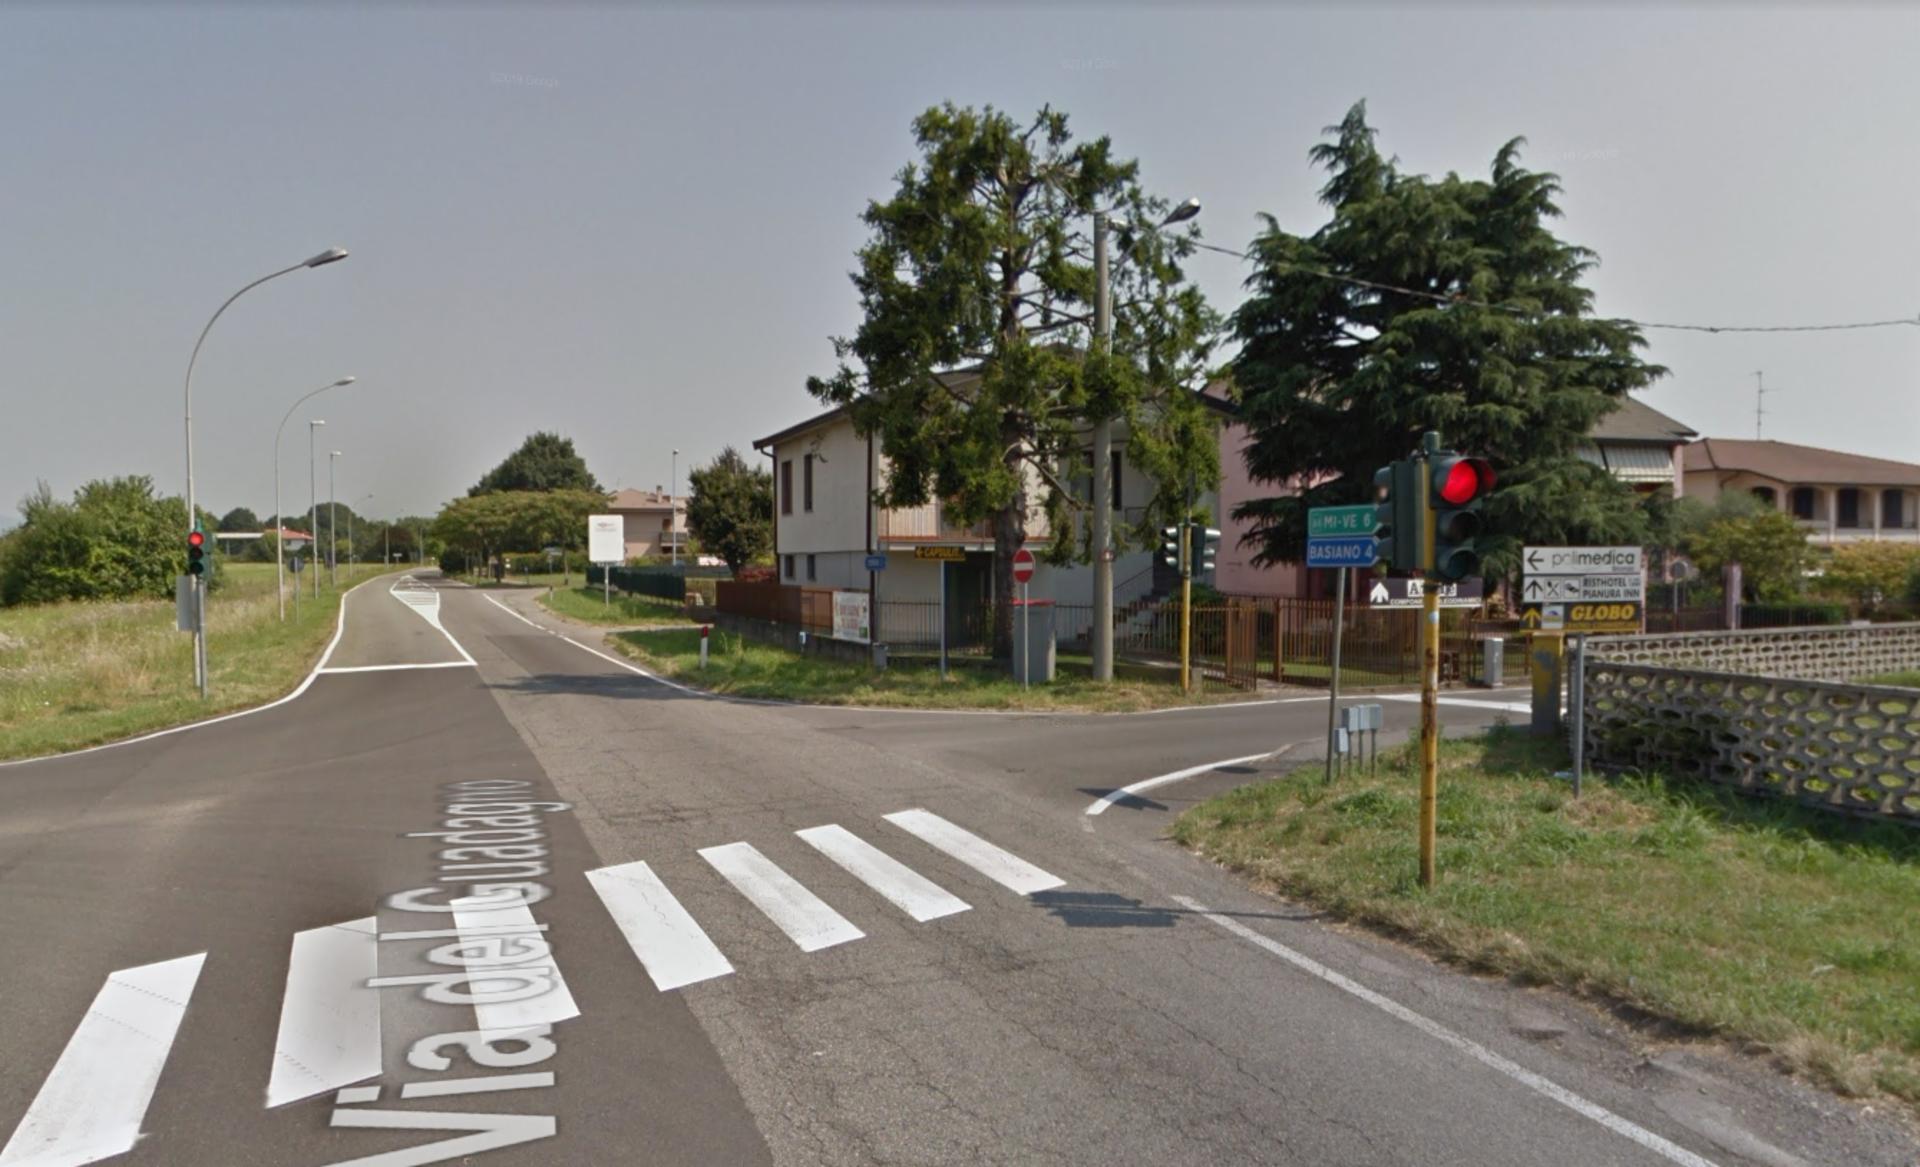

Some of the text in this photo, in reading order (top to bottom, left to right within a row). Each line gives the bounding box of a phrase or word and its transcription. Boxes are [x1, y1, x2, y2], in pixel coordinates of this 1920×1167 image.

[1324, 514, 1358, 529] MI-VE
[1364, 513, 1372, 527] 6
[1310, 544, 1373, 560] BASIANO 4
[1552, 550, 1635, 567] polimedica
[1582, 577, 1628, 588] RISTHOTEL
[1582, 588, 1641, 598] PIANURA INN
[1570, 605, 1635, 621] GLOBO
